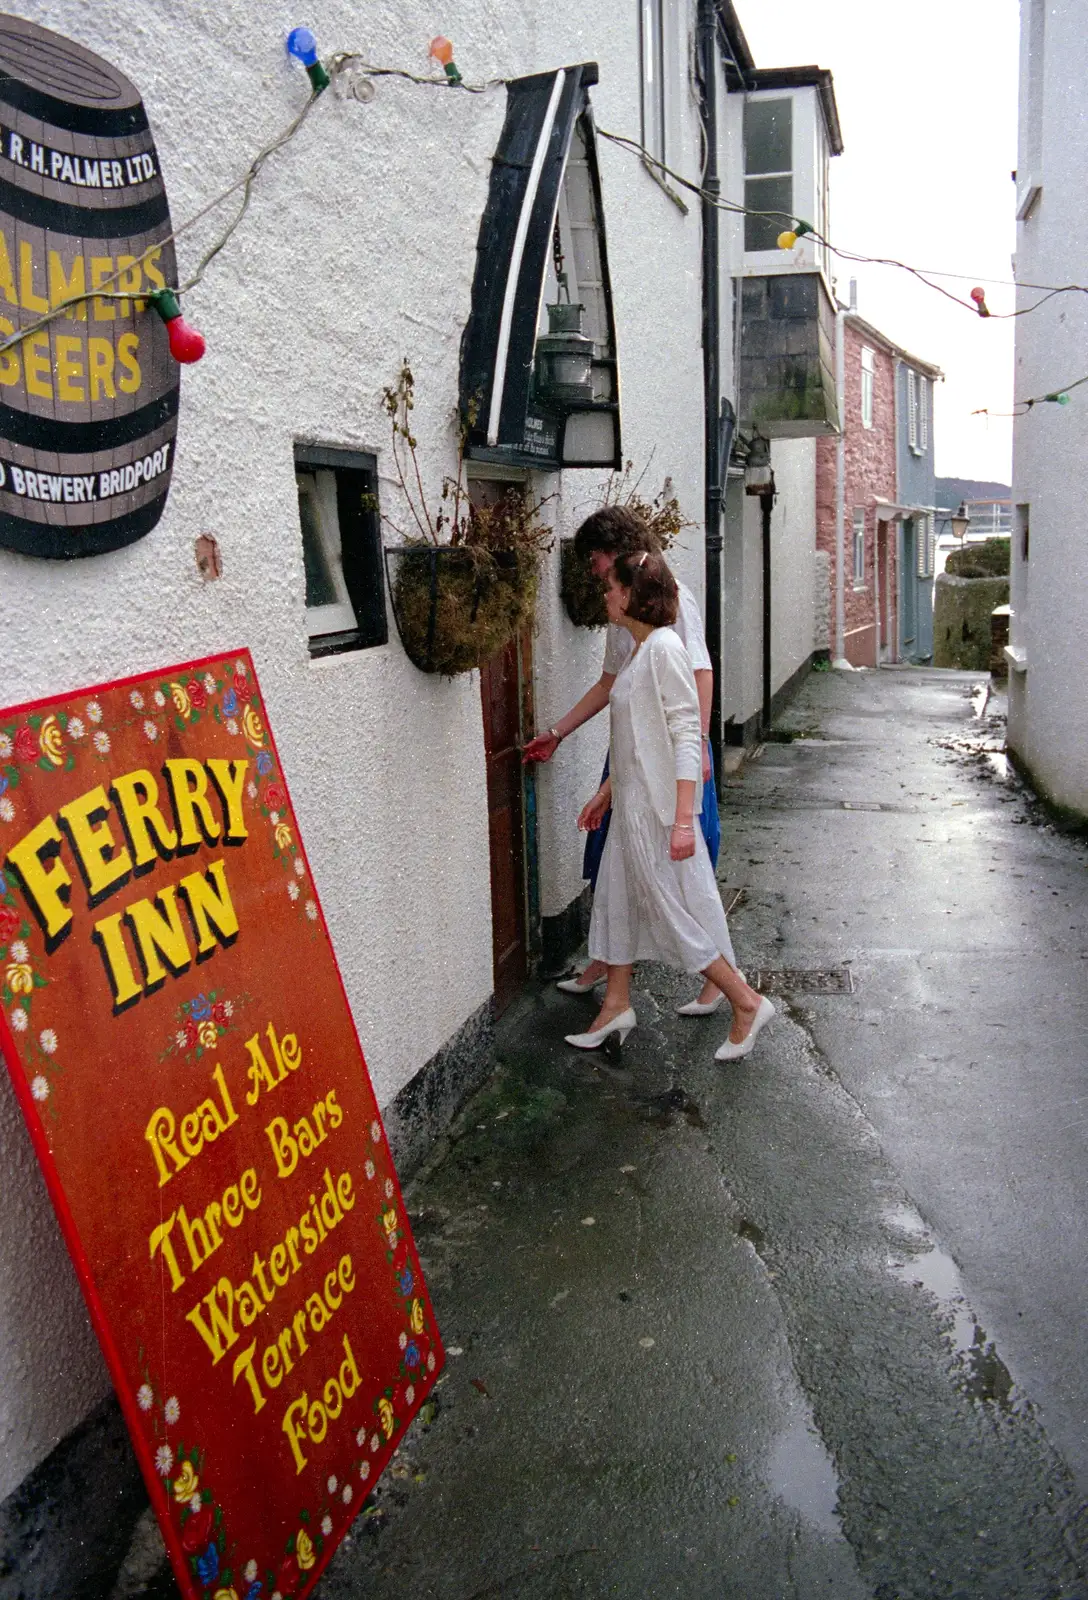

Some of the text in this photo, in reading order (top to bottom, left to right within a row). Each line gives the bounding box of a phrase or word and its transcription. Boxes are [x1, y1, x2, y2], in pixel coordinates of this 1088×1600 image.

[125, 153, 156, 184] LTD.
[100, 443, 169, 498] BRIDPORT
[6, 757, 249, 940] FERRY
[94, 859, 240, 1008] INN
[145, 1022, 302, 1187] Real Ale
[150, 1089, 343, 1292] Three Bars
[186, 1168, 356, 1366] Waterside
[233, 1253, 356, 1414] Terrace
[282, 1334, 363, 1475] Food
